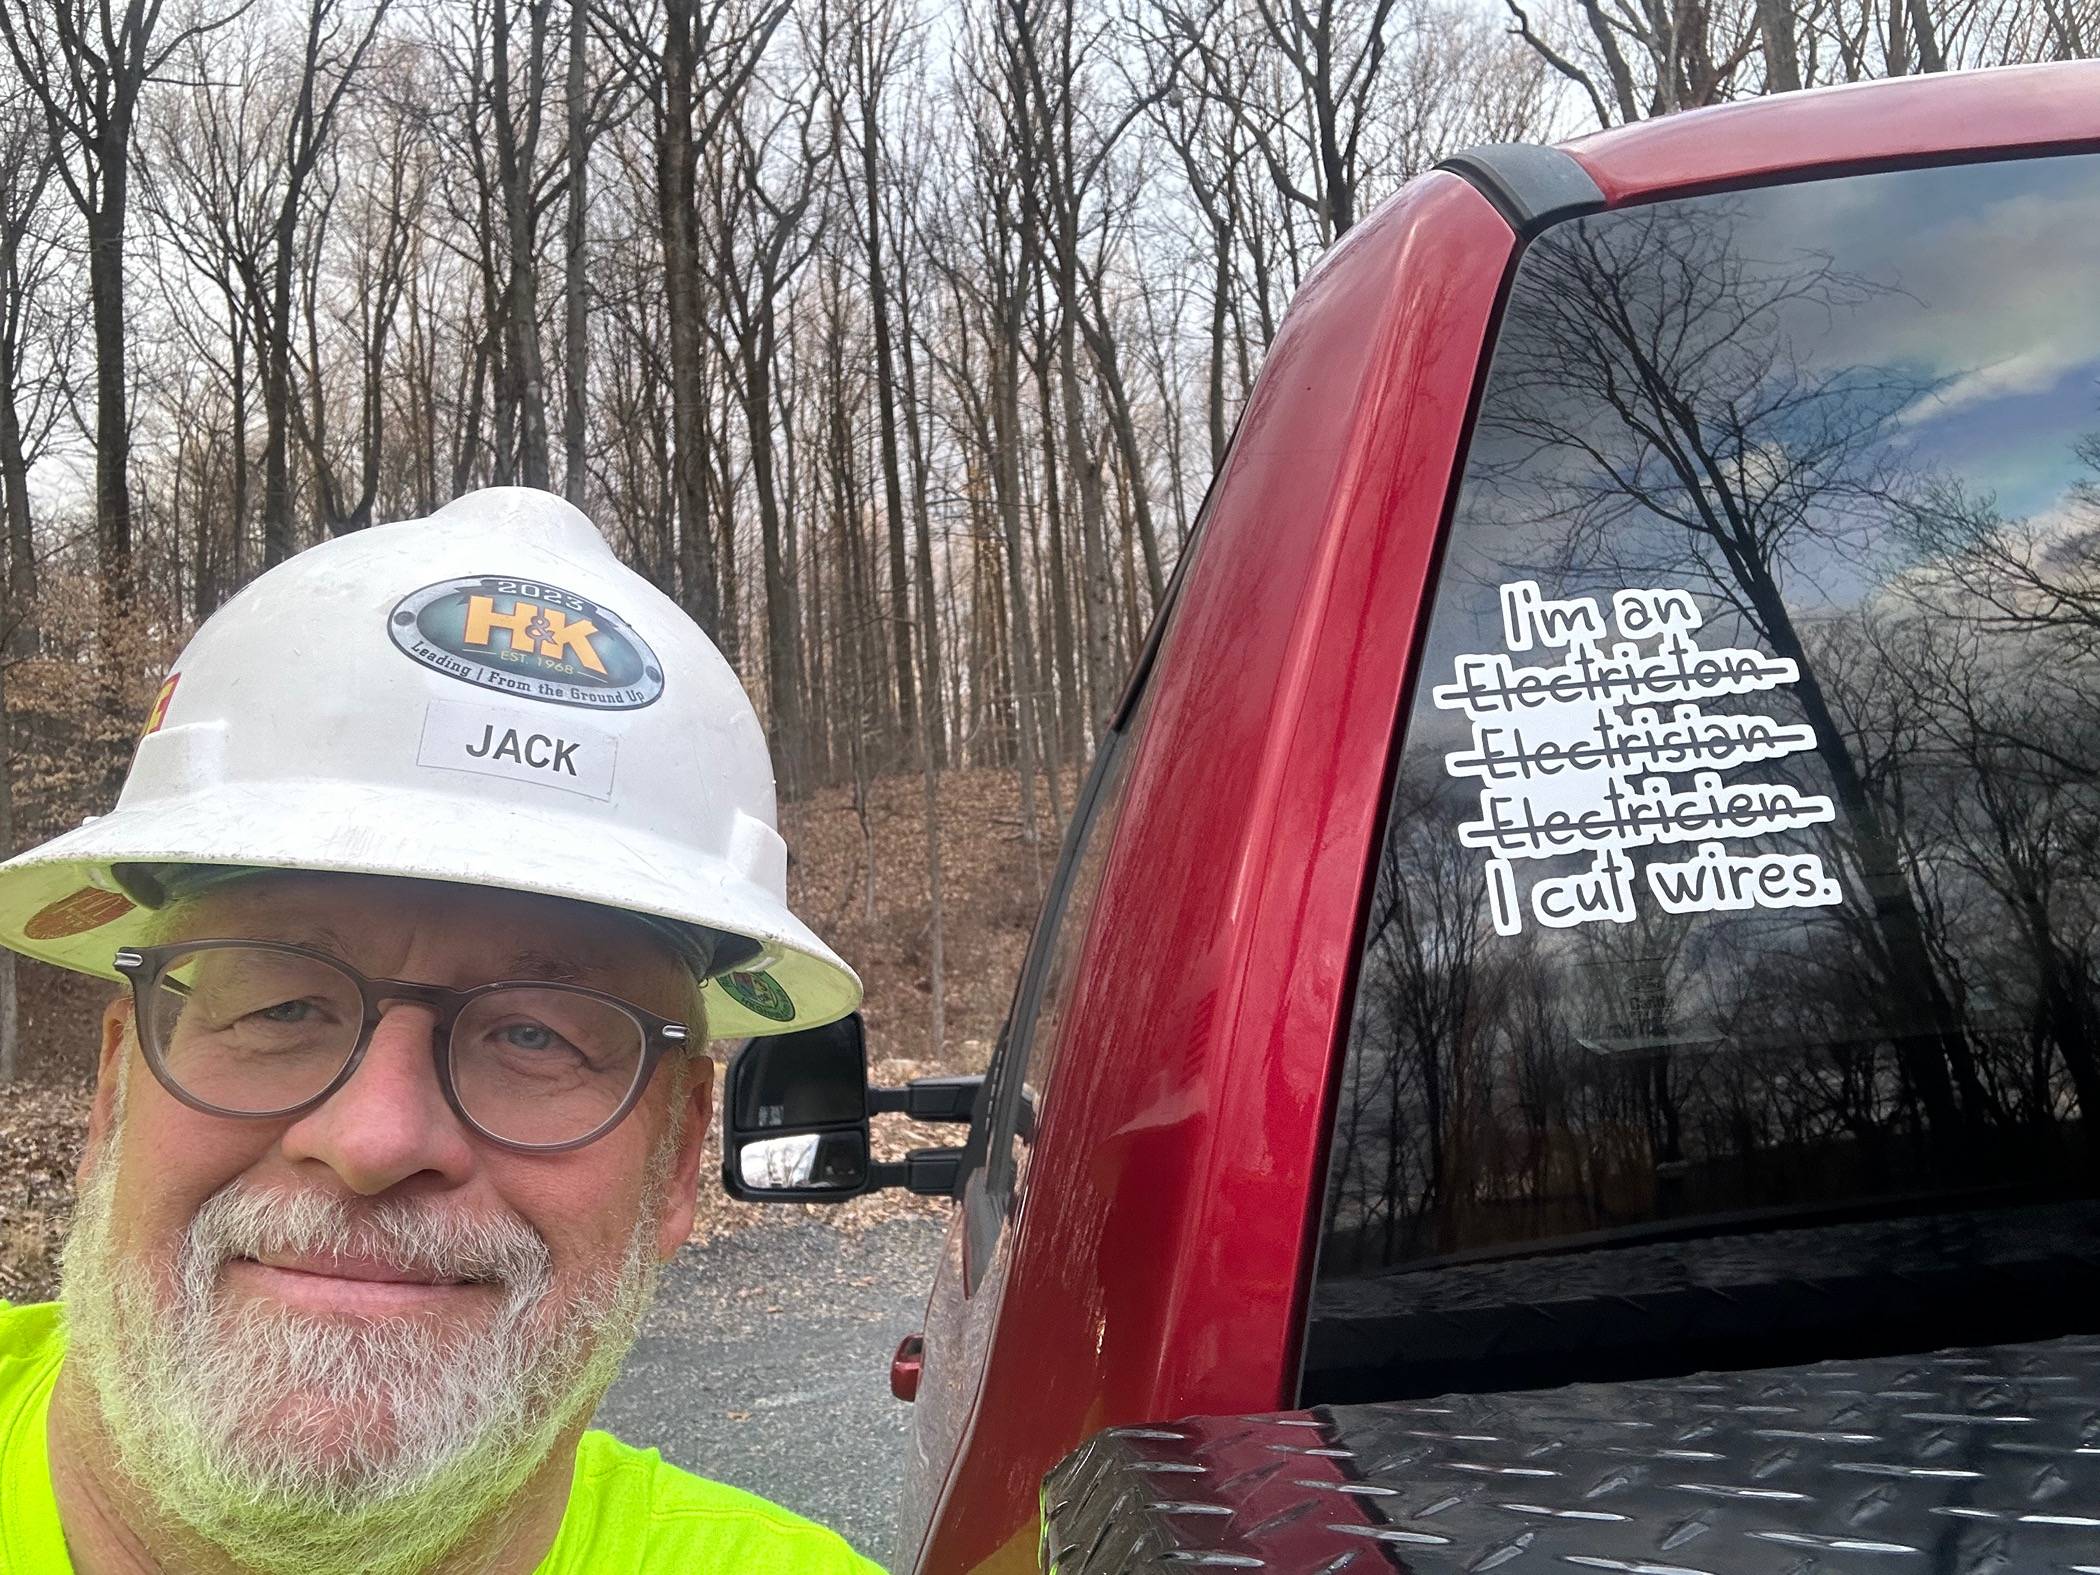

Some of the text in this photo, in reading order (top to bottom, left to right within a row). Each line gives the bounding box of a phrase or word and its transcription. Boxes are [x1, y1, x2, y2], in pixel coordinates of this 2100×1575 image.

[498, 581, 584, 611] 2023
[1508, 588, 1691, 643] I'm an
[463, 595, 608, 675] H&K
[501, 650, 575, 675] EST. 1968
[411, 641, 472, 677] Leading
[487, 671, 531, 692] From
[538, 683, 564, 698] the
[570, 687, 625, 704] Ground
[626, 689, 646, 704] Up
[1463, 633, 1764, 712] Electricton
[465, 724, 581, 777] JACK
[1481, 708, 1776, 780] Electrisian
[1490, 777, 1798, 850] Electricien
[1493, 849, 1831, 926] I cut wires.
